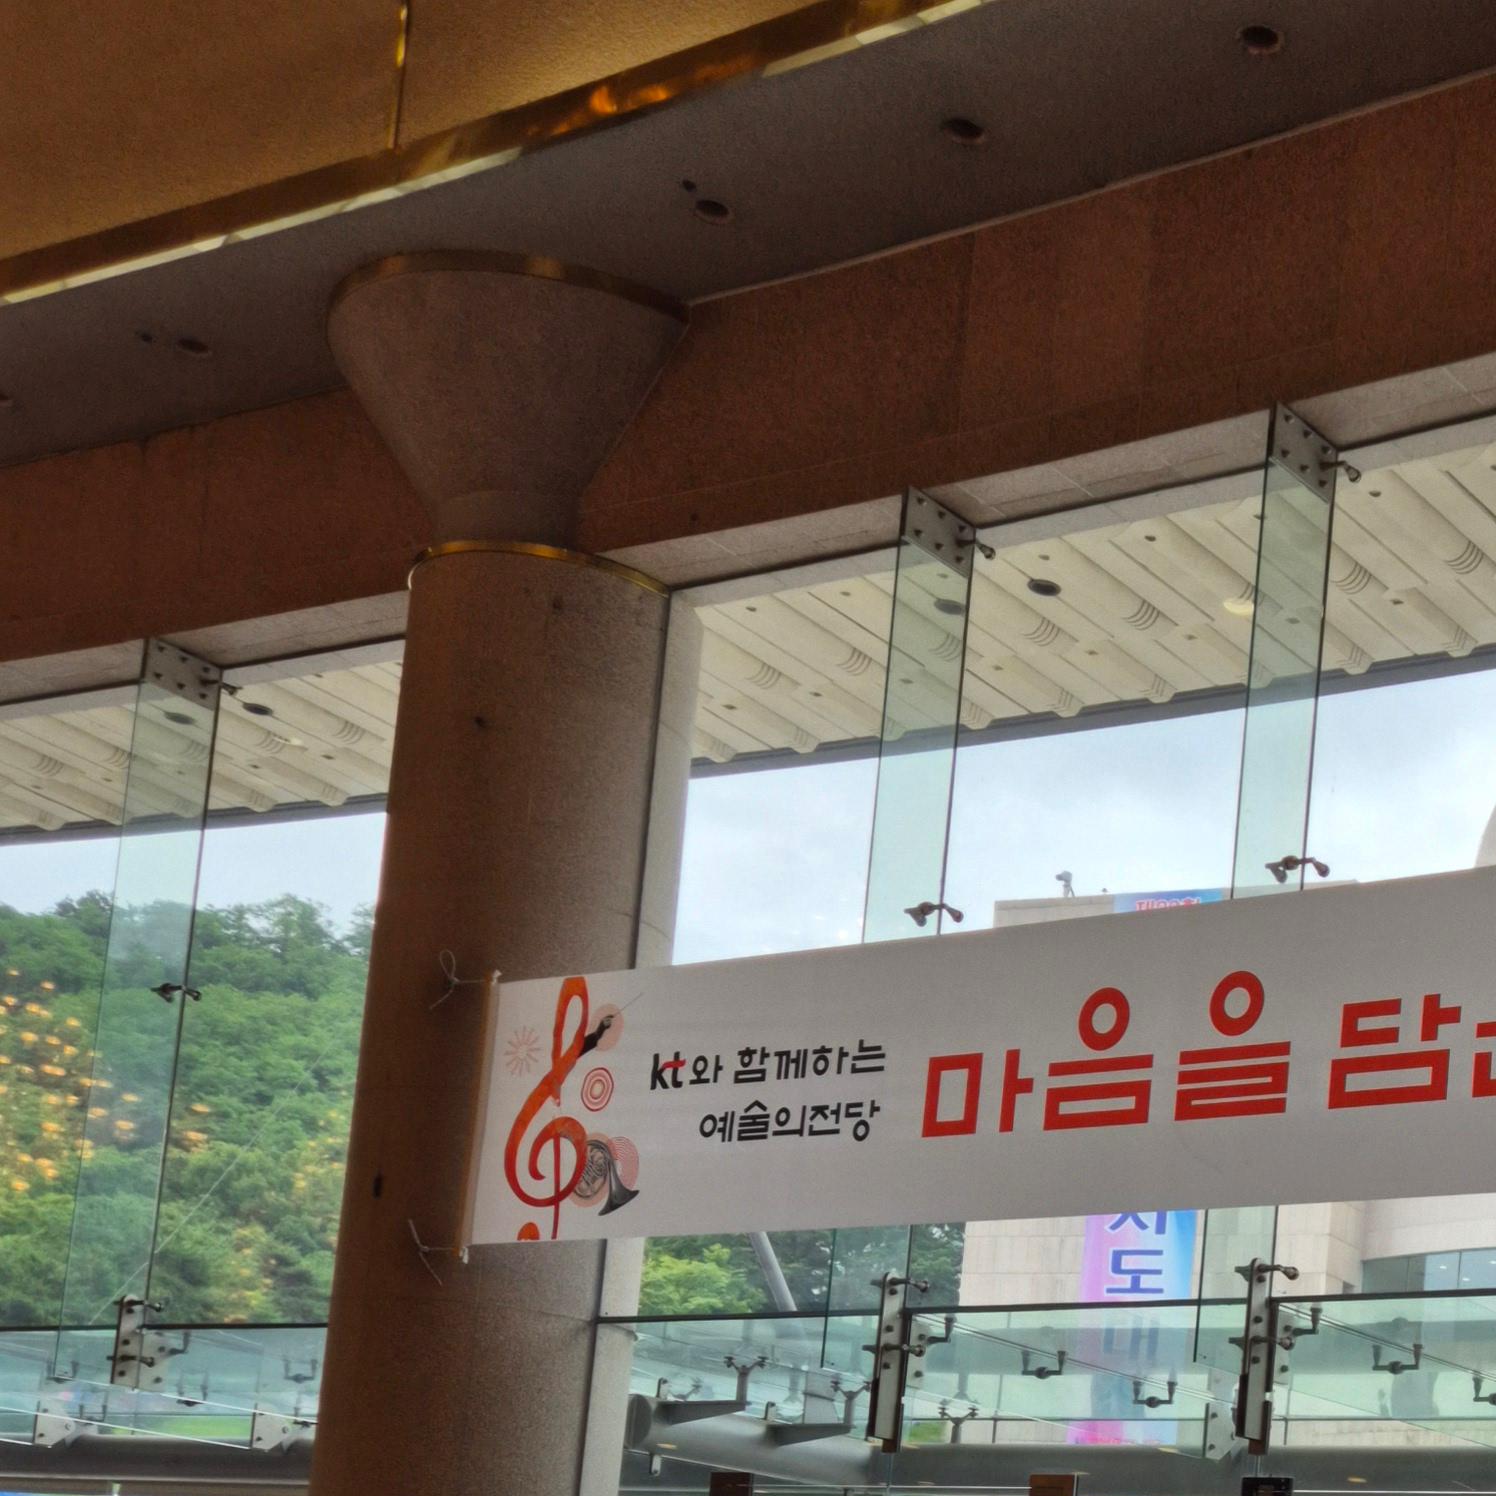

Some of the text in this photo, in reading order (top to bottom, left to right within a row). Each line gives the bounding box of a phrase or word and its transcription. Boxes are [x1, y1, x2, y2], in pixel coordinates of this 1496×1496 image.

[733, 1039, 886, 1084] 함께하는
[922, 971, 1290, 1138] 마음을
[699, 1100, 881, 1142] 예술의전당
